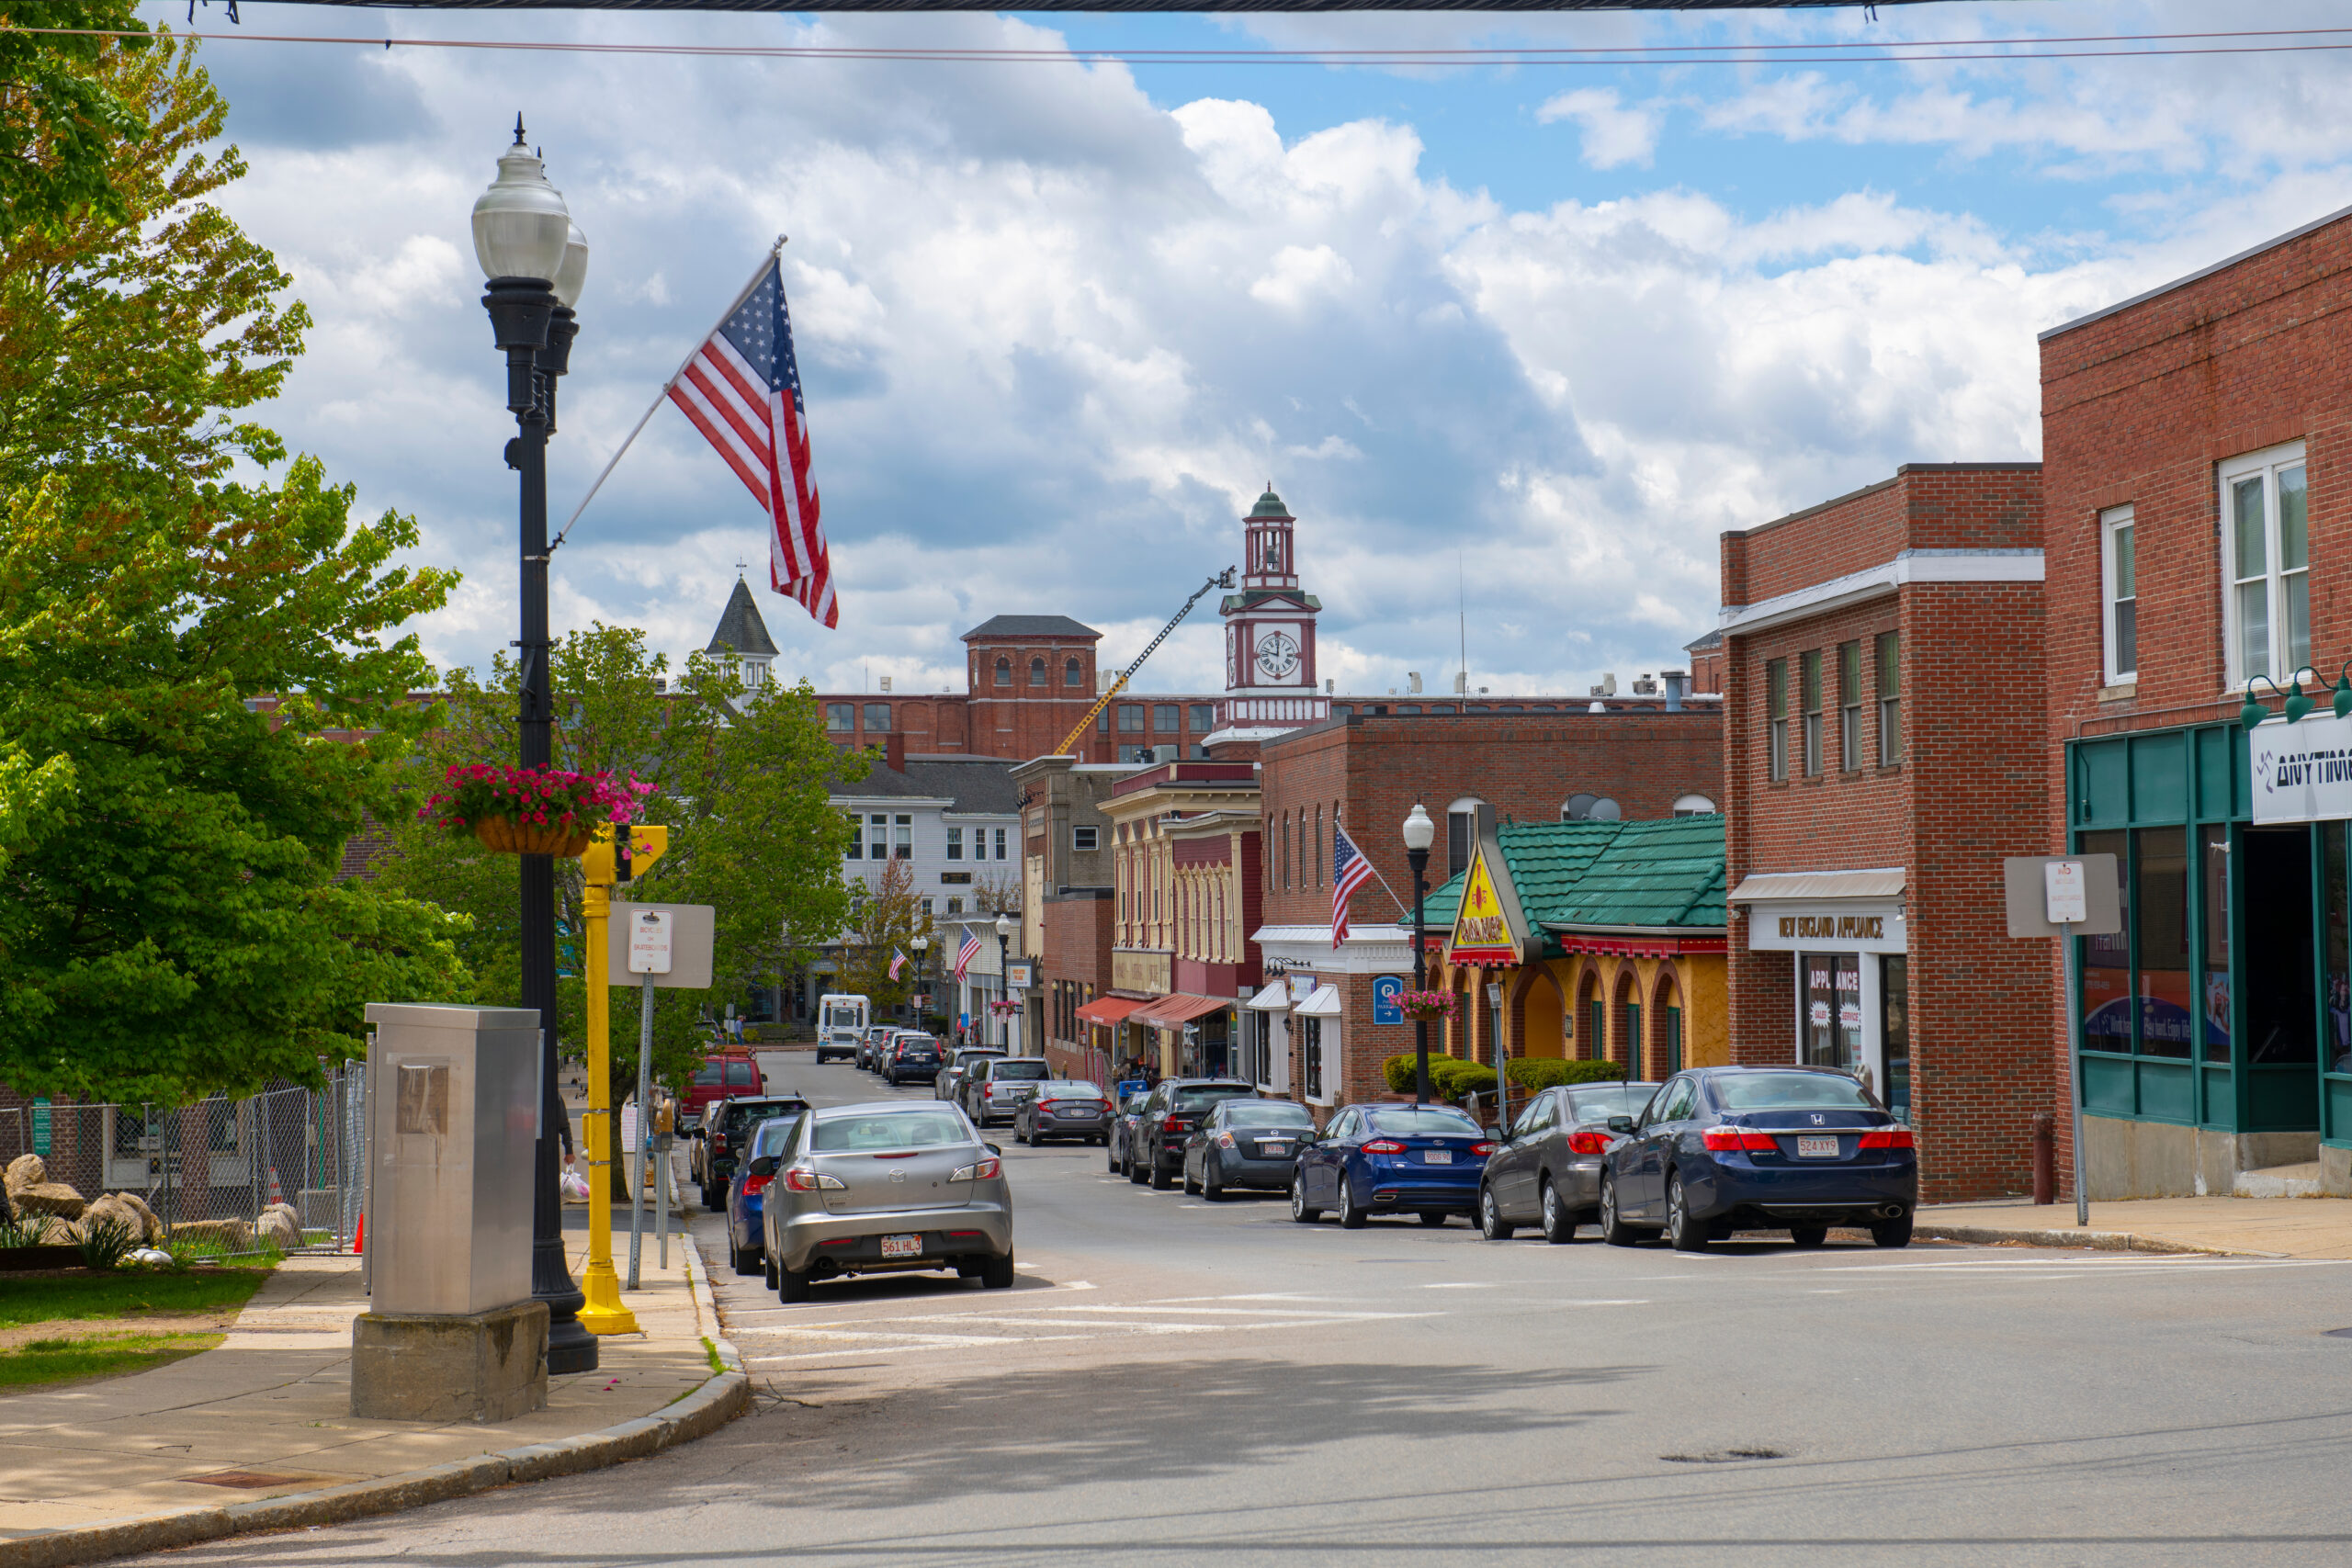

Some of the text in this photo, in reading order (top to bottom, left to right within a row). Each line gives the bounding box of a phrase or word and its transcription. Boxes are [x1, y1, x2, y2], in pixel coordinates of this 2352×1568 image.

[1779, 916, 1883, 939] NEW ENGLAND APPLIANCE
[1815, 1010, 1826, 1020] SALES
[1842, 1011, 1859, 1021] SERVICE
[1800, 1140, 1837, 1151] 524 XY9
[882, 1239, 922, 1253] 561 HL3
